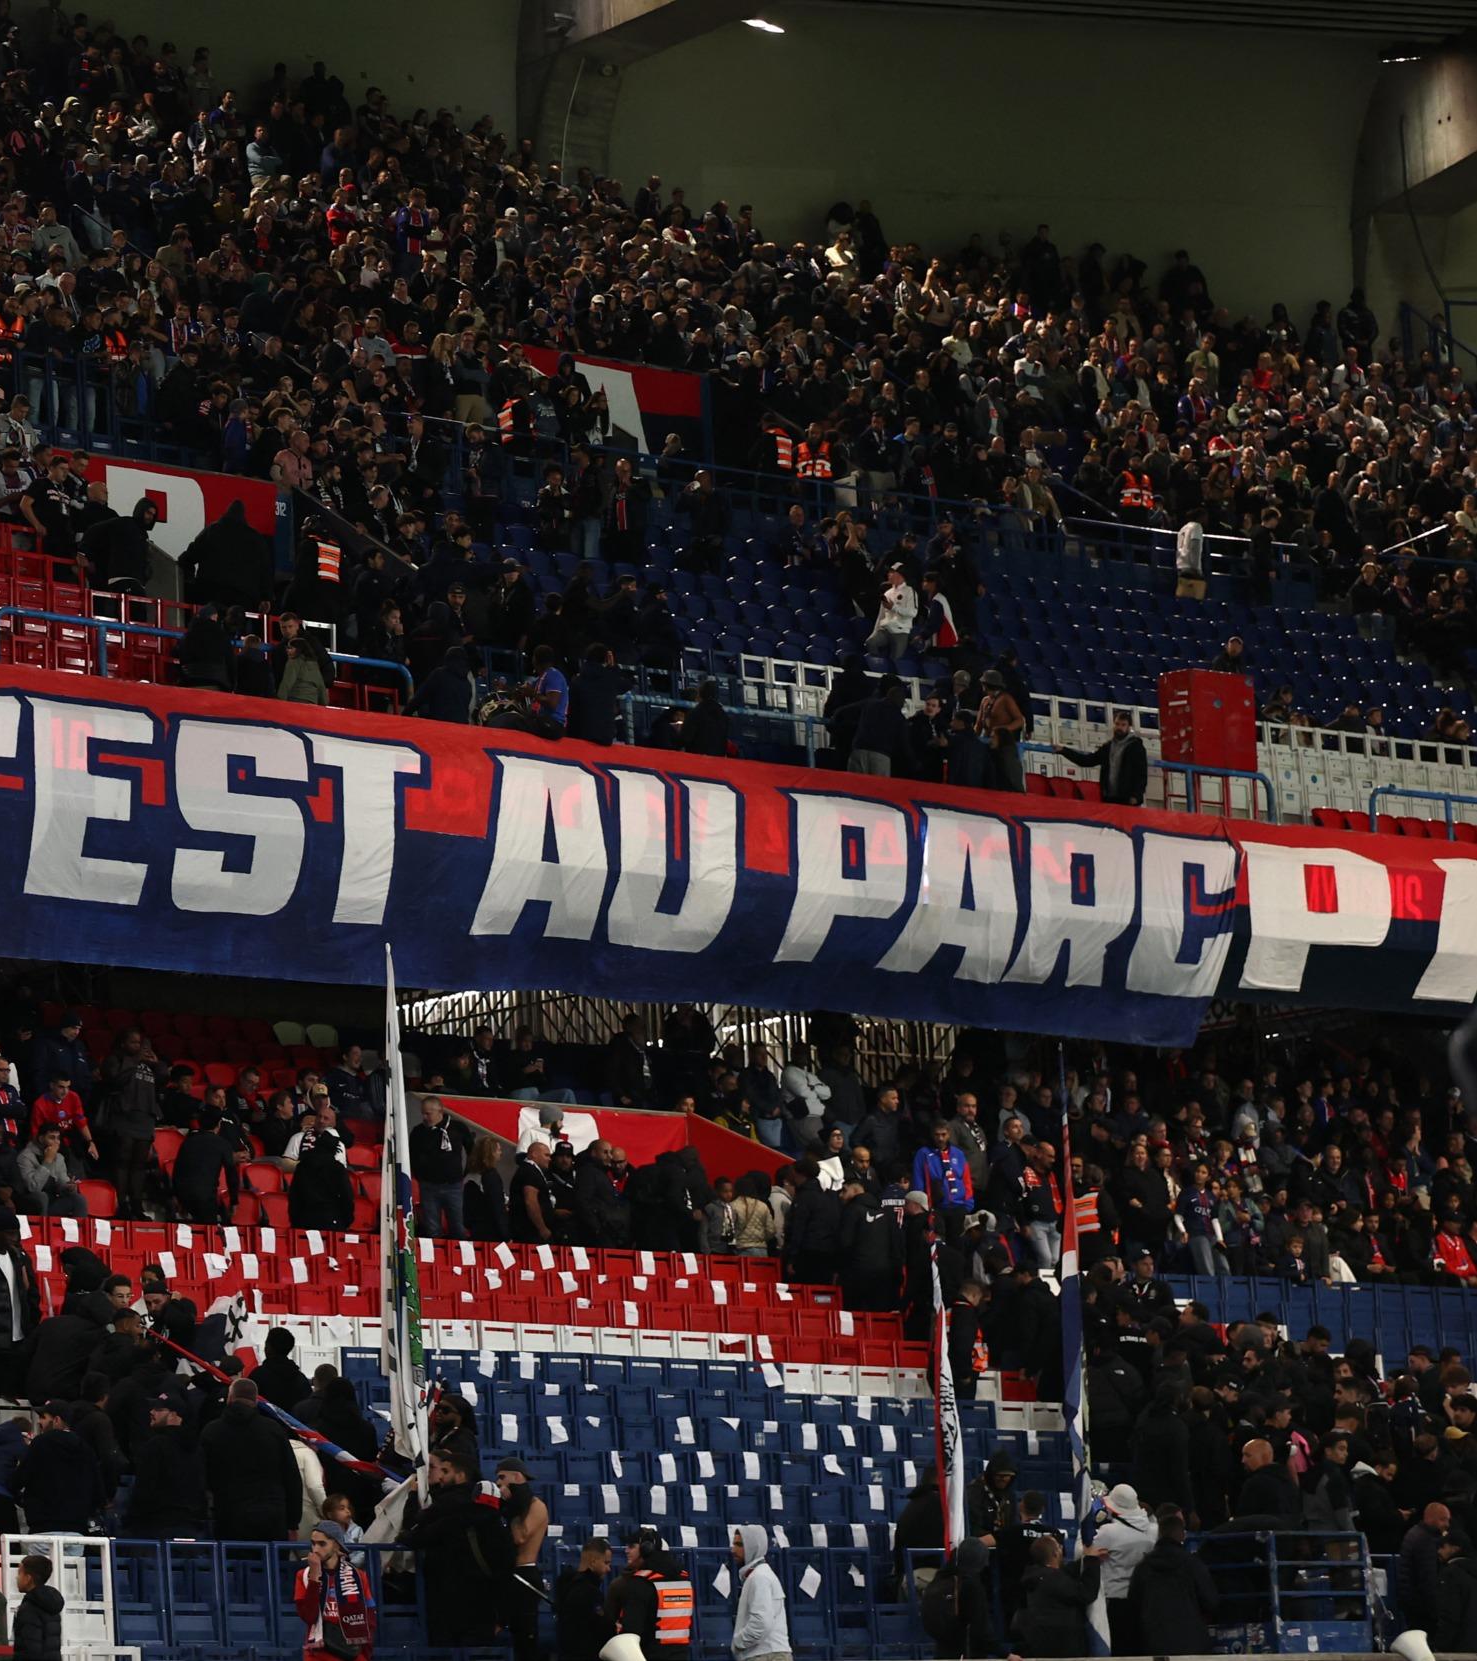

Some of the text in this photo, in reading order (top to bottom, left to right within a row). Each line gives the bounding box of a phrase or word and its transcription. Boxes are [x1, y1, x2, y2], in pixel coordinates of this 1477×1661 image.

[469, 754, 738, 954] AU
[772, 791, 1237, 998] PARC
[342, 1613, 364, 1623] QATAR
